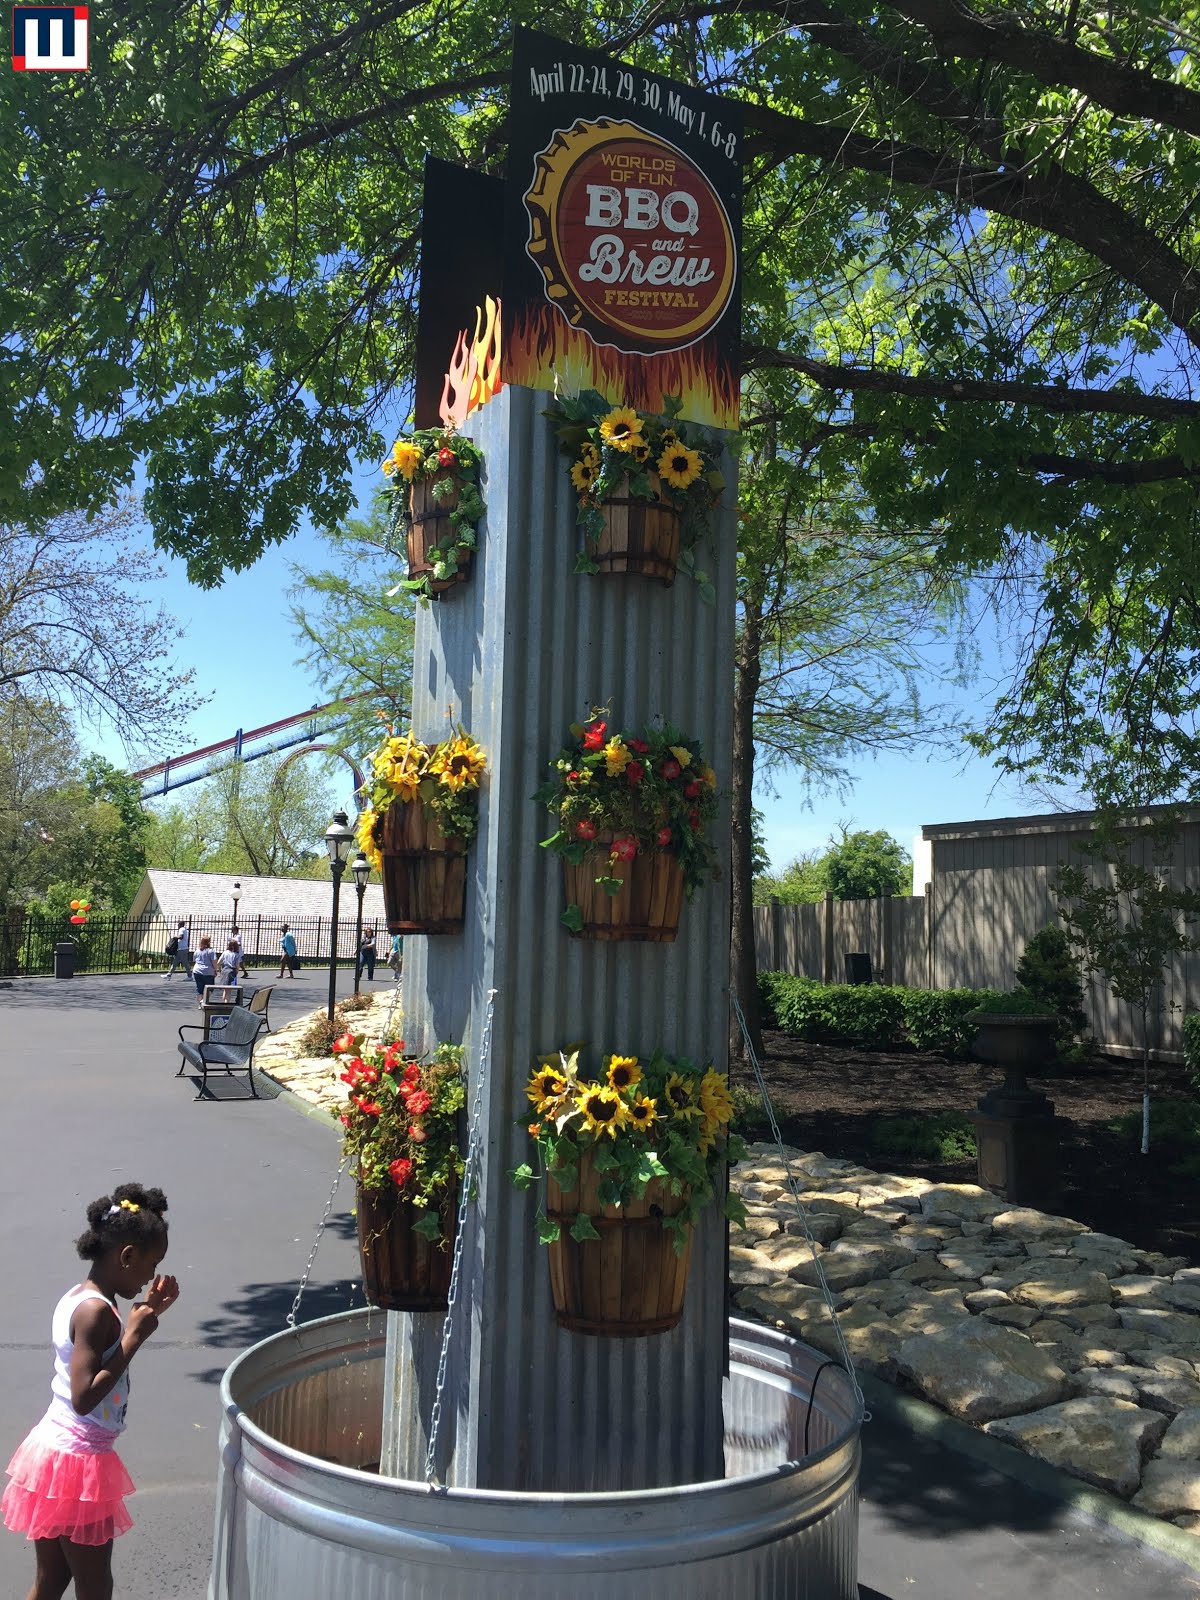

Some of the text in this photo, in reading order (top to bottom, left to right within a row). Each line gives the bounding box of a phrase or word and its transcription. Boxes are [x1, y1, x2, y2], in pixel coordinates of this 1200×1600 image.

[530, 63, 737, 159] April 22-24, 29, 30, May 1, 6-8
[601, 153, 676, 171] WORLDS
[610, 169, 673, 186] OF FUN
[585, 184, 699, 236] BBQ
[651, 237, 685, 252] and
[578, 233, 715, 287] Brew
[604, 289, 699, 308] FESTIVAL
